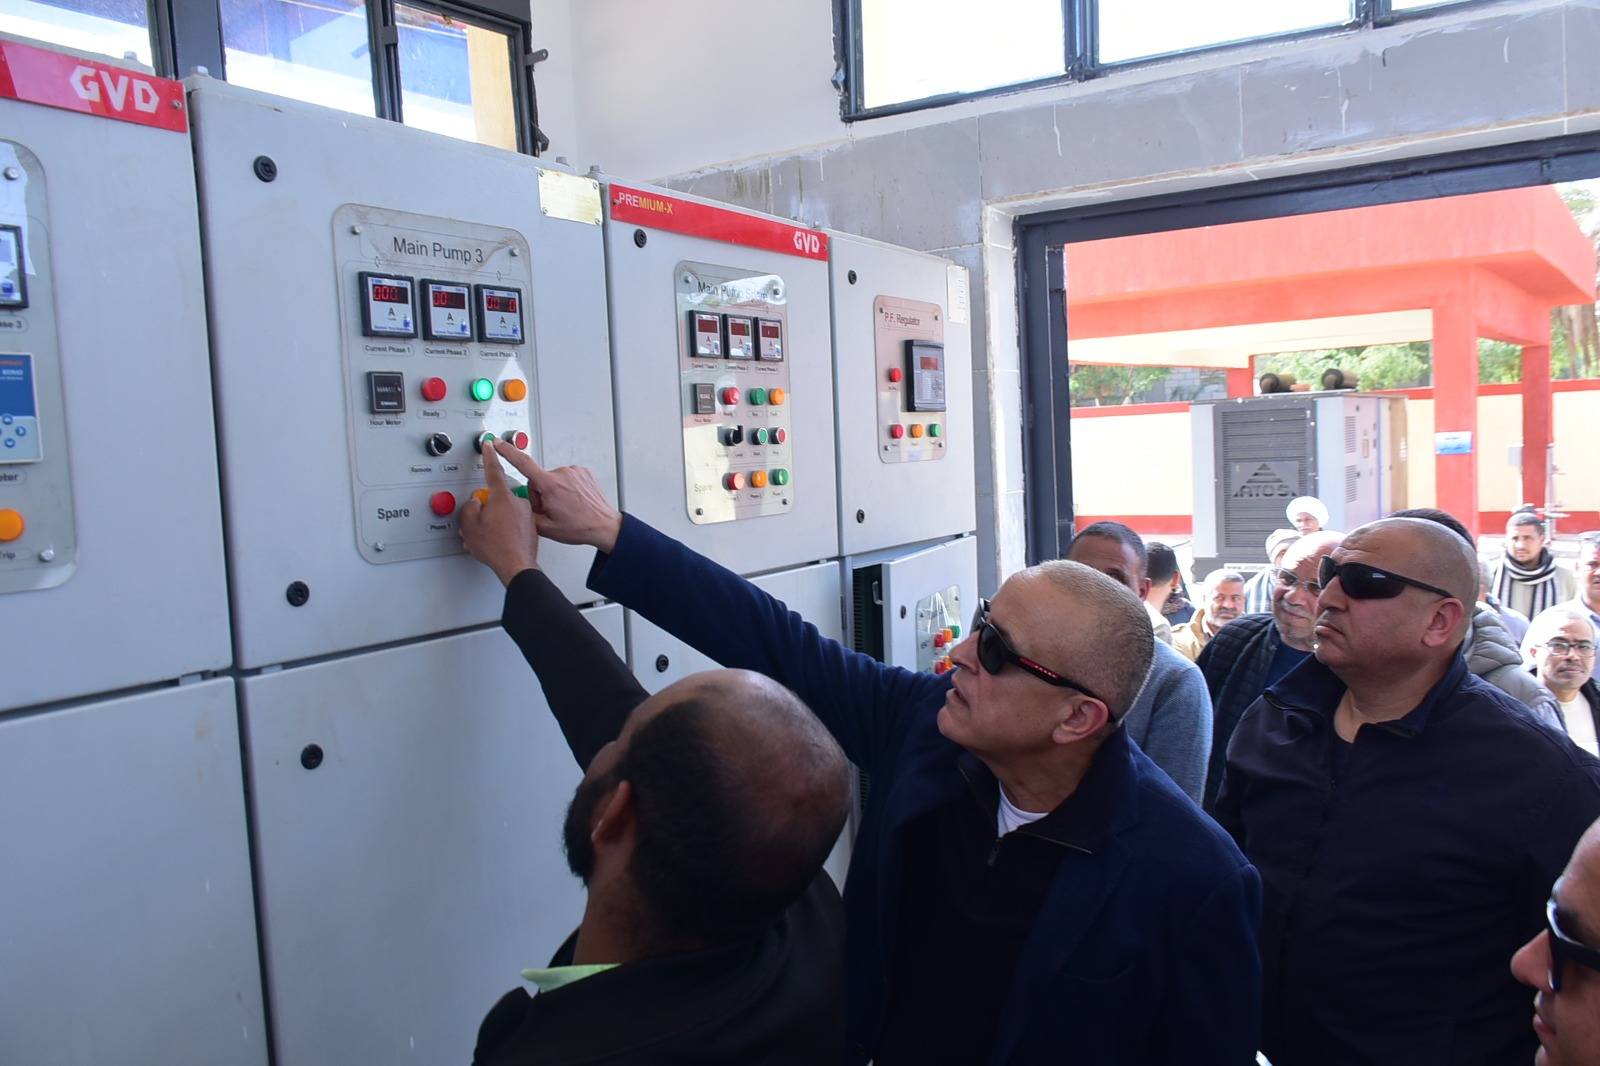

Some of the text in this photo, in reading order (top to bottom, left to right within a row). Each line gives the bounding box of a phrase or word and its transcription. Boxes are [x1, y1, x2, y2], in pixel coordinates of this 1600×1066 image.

[69, 65, 160, 114] GVD
[618, 191, 673, 215] PREMIUM-X
[793, 231, 820, 254] GVD
[393, 236, 484, 264] Main Pump 3
[697, 281, 719, 296] Main
[388, 307, 396, 316] A
[446, 312, 454, 321] A
[500, 315, 506, 324] A
[896, 313, 920, 327] Regulator
[377, 507, 410, 521] Spare
